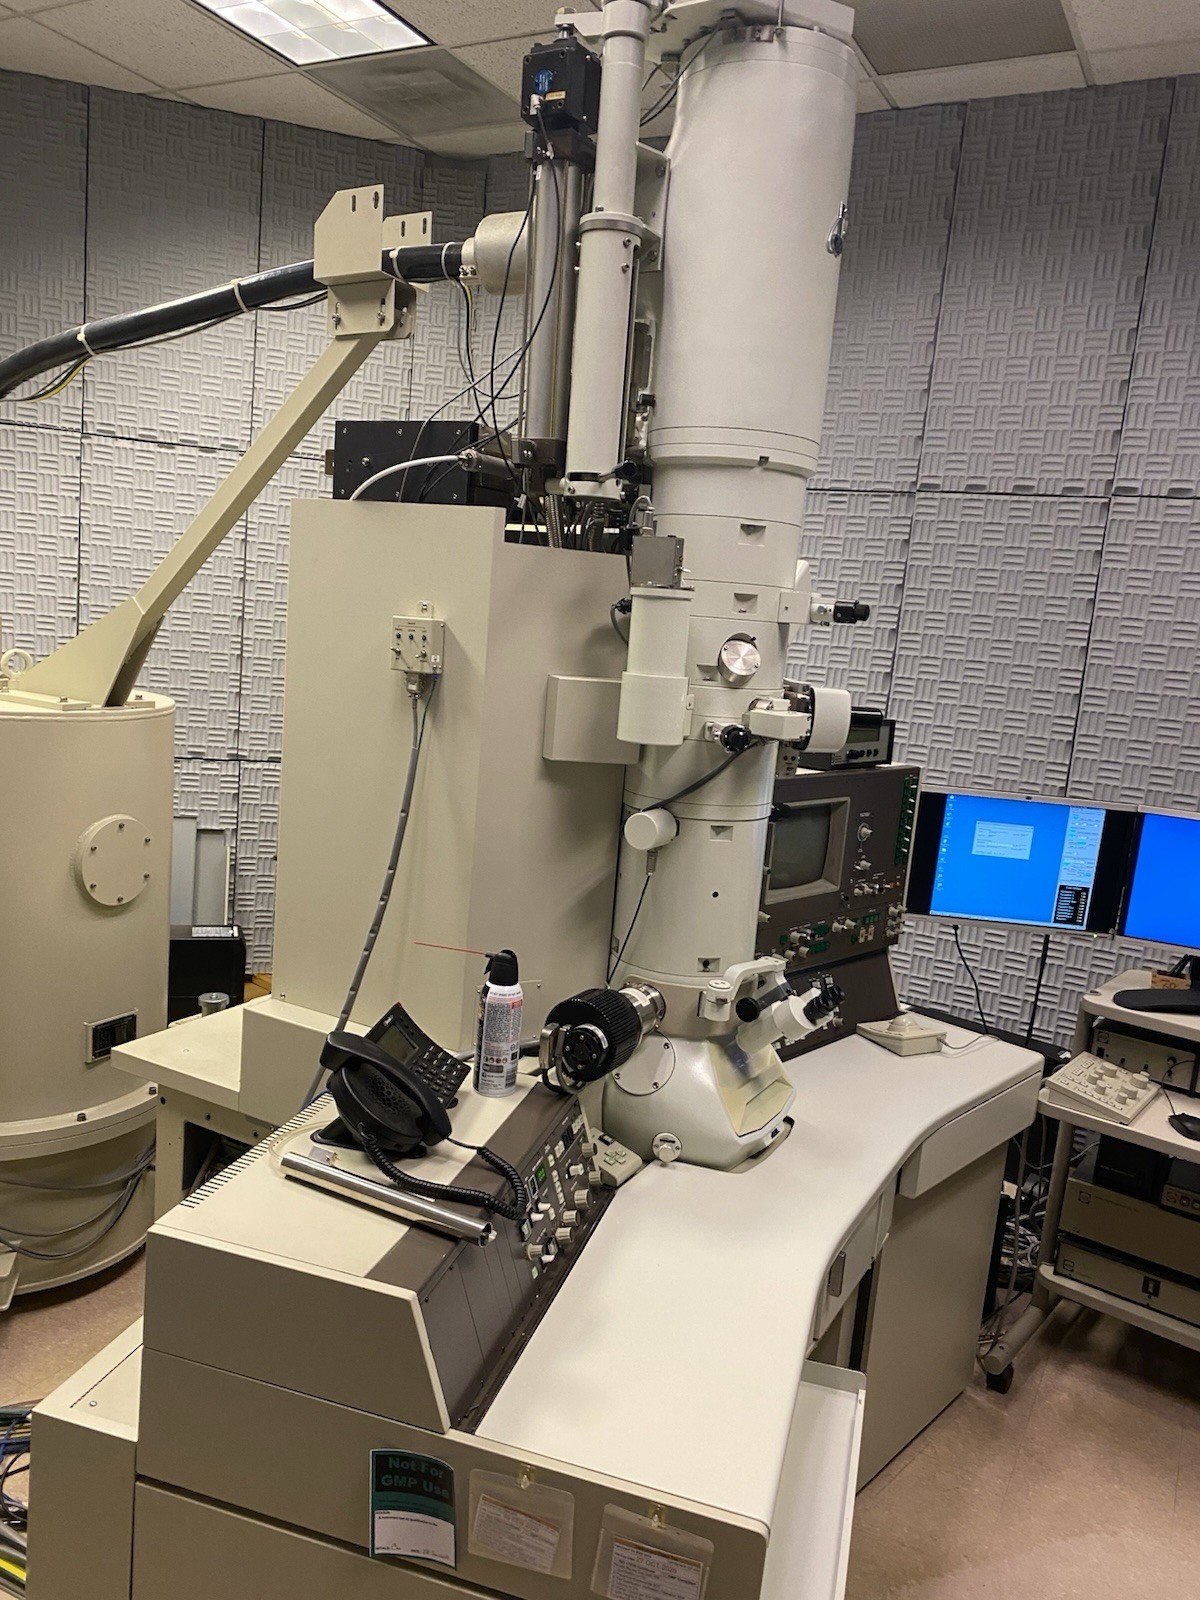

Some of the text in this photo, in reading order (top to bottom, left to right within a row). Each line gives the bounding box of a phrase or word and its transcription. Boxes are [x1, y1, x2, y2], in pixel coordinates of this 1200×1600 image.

[388, 1457, 445, 1479] Not For
[381, 1474, 450, 1498] GMP Use
